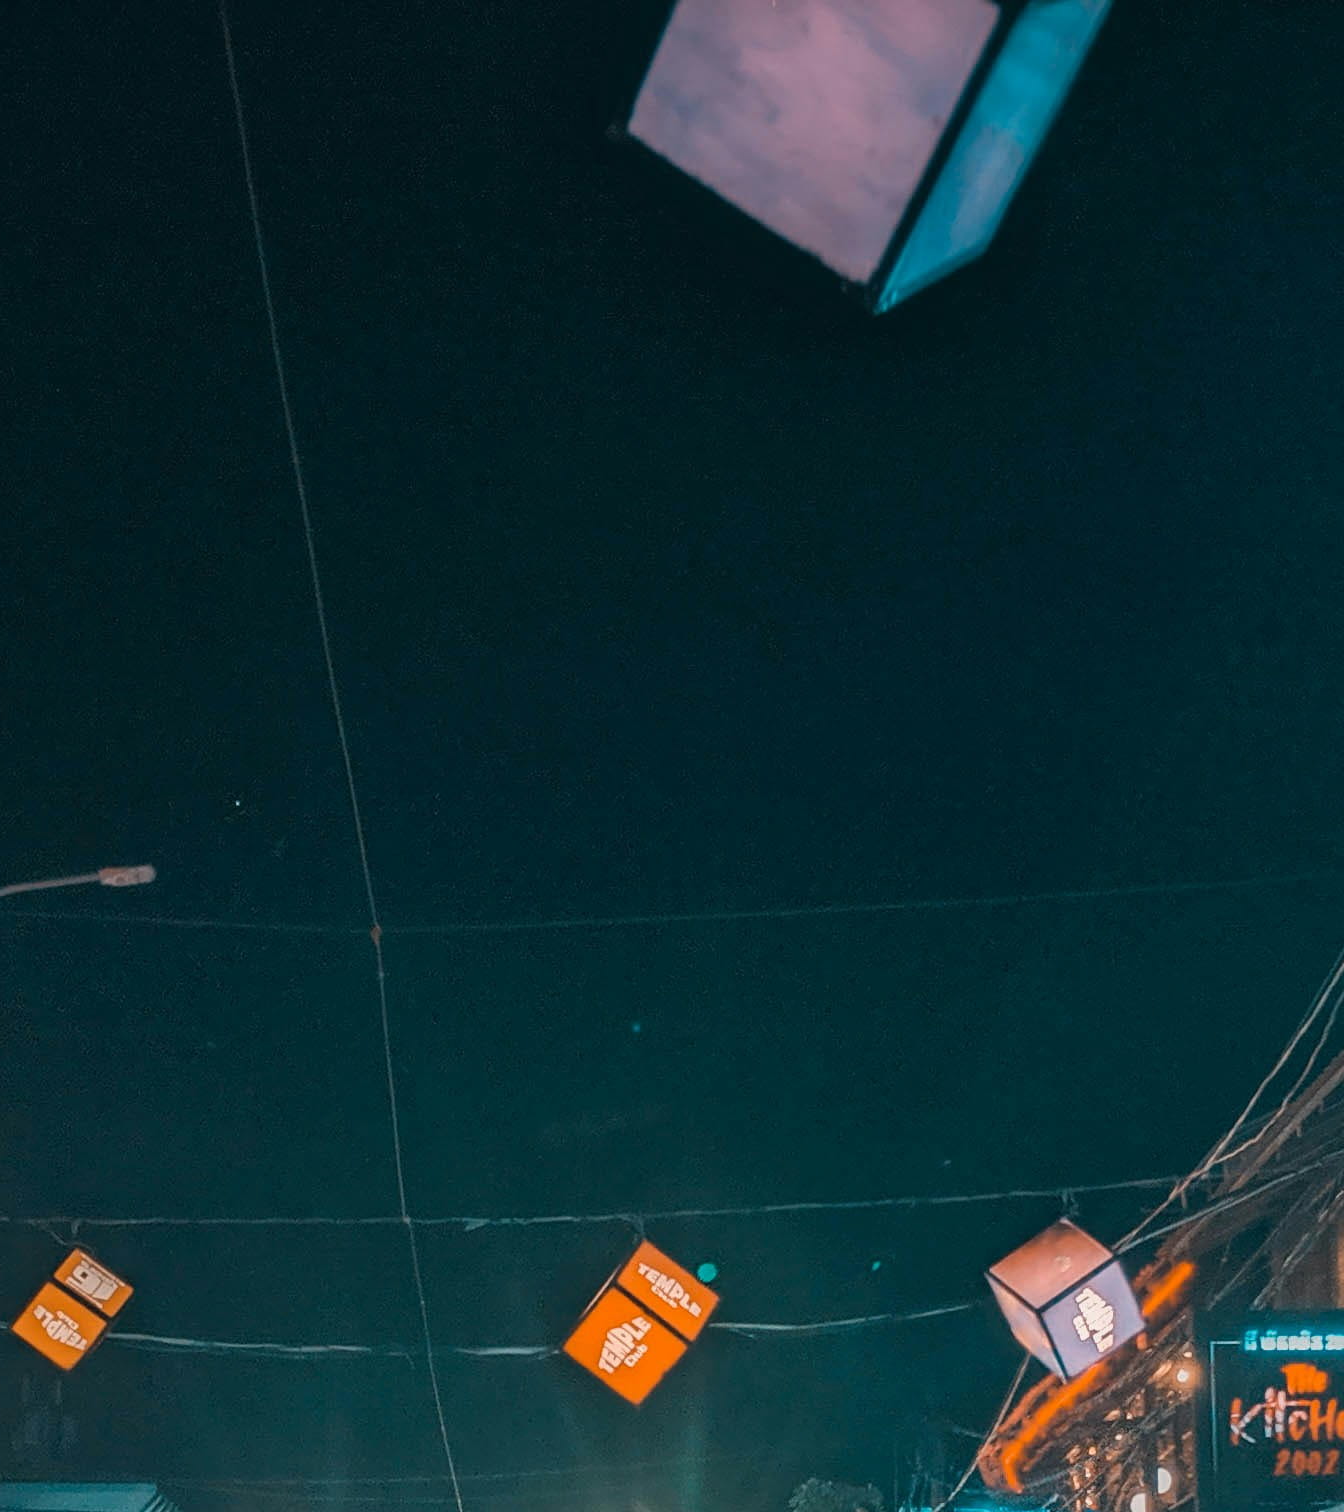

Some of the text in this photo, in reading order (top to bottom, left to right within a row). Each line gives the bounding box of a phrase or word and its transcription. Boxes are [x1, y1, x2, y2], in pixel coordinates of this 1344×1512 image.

[638, 1262, 703, 1318] TEMPLE
[32, 1303, 89, 1352] TEMPLE
[597, 1315, 653, 1374] TEMPLE
[1074, 1286, 1115, 1353] TEMPLE
[1272, 1448, 1340, 1477] 2002
